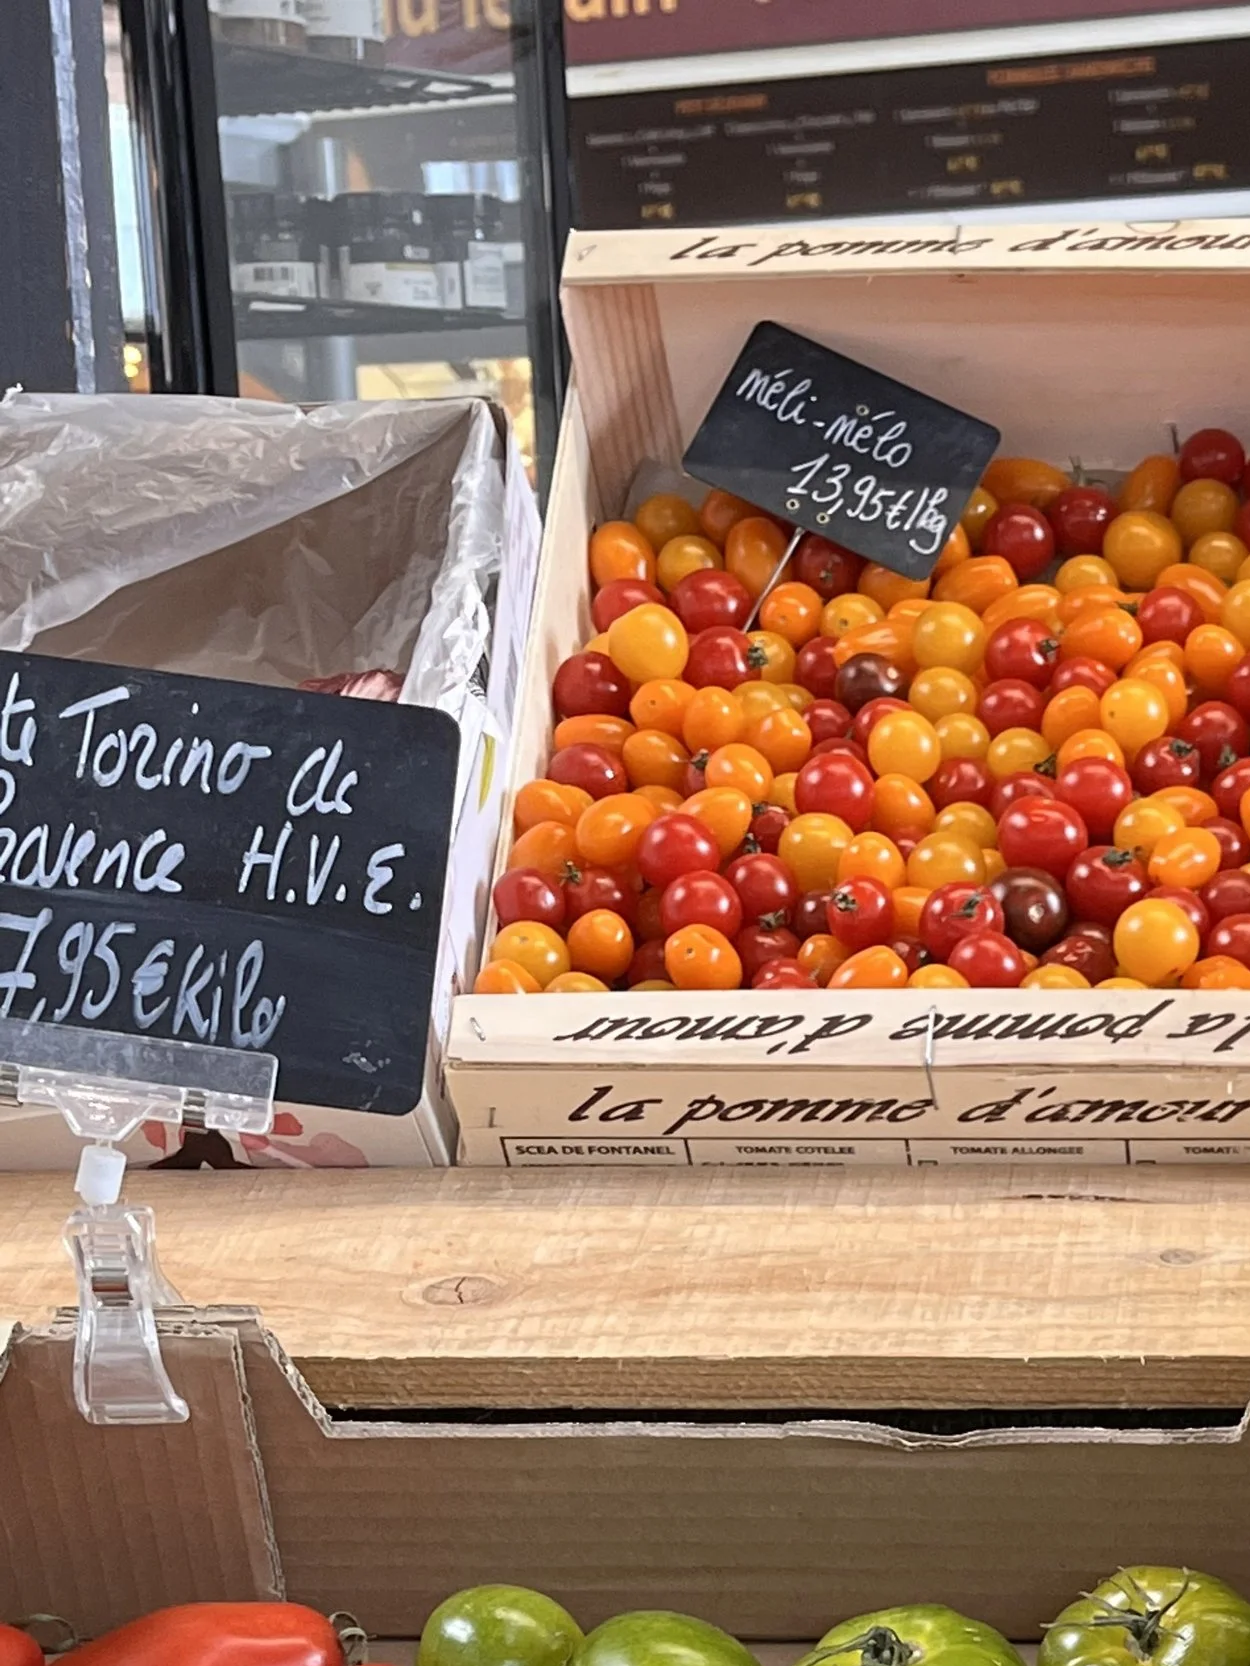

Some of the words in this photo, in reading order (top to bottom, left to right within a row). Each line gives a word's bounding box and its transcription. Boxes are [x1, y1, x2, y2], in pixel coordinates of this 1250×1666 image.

[669, 236, 755, 261] la
[747, 234, 993, 266] pomme
[58, 686, 271, 795] Torino
[286, 739, 358, 816] de
[553, 1013, 873, 1055] d'amour
[889, 999, 1175, 1041] pomme
[568, 1085, 662, 1122] la
[663, 1095, 935, 1135] pomme
[515, 1145, 558, 1155] SCEA
[562, 1145, 585, 1155] DE
[588, 1145, 676, 1155] FONTANEL
[736, 1146, 791, 1154] TOMATE
